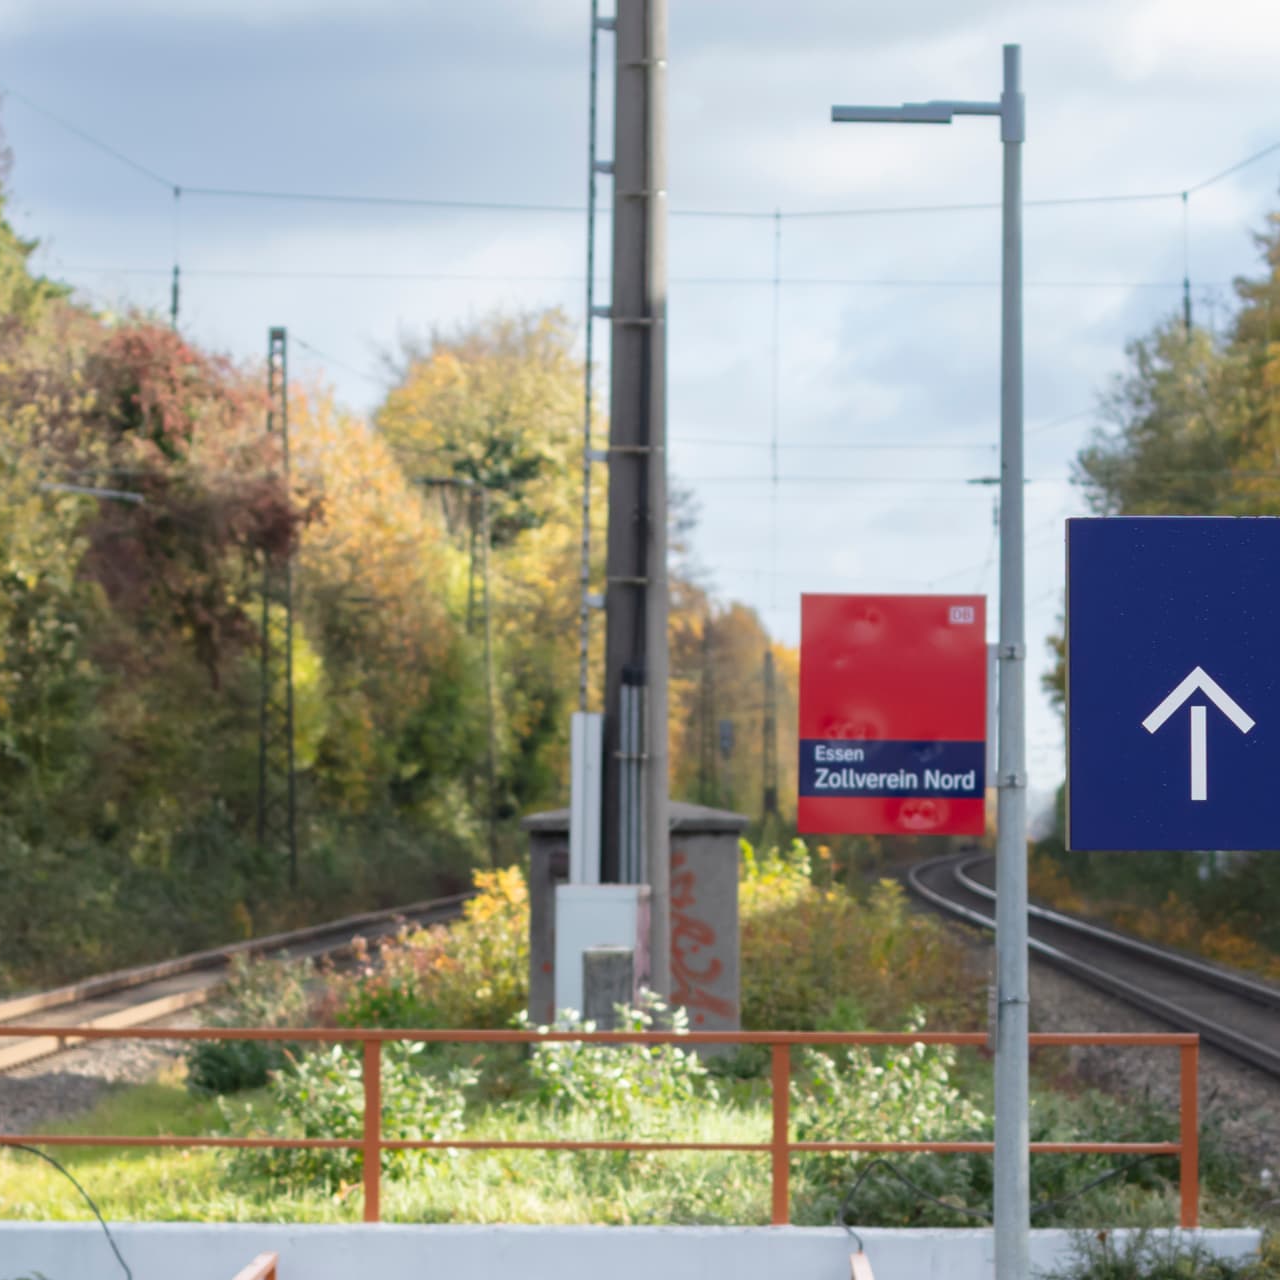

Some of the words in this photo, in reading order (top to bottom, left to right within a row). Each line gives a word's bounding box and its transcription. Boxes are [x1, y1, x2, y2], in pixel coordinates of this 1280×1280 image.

[814, 744, 865, 762] Essen
[814, 767, 919, 790] Zollverein
[923, 769, 976, 790] Nord
